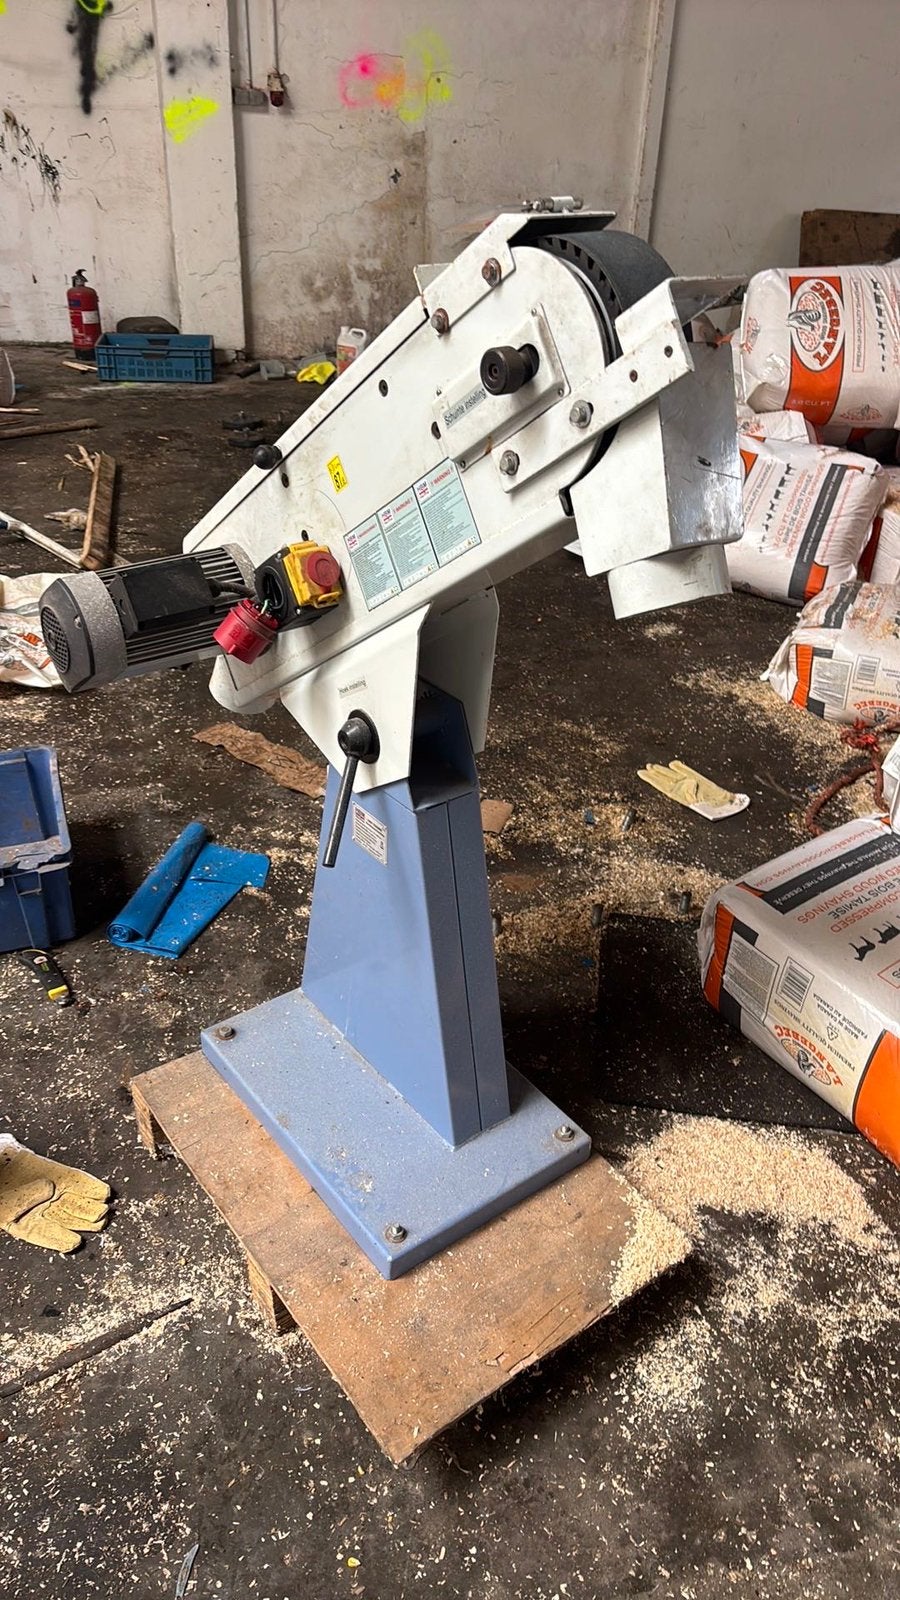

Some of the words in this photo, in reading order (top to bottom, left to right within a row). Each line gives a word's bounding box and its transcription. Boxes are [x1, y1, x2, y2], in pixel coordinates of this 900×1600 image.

[853, 875, 886, 892] WOOD
[868, 881, 896, 898] BOIS
[797, 889, 854, 924] SHAVINGS
[811, 991, 835, 1012] CANADA
[815, 1002, 838, 1022] CANADA
[800, 1022, 828, 1046] QUALITY
[843, 1024, 860, 1040] MADE
[774, 1024, 844, 1087] LANGEBEC
[825, 1043, 857, 1071] PREMIUM
